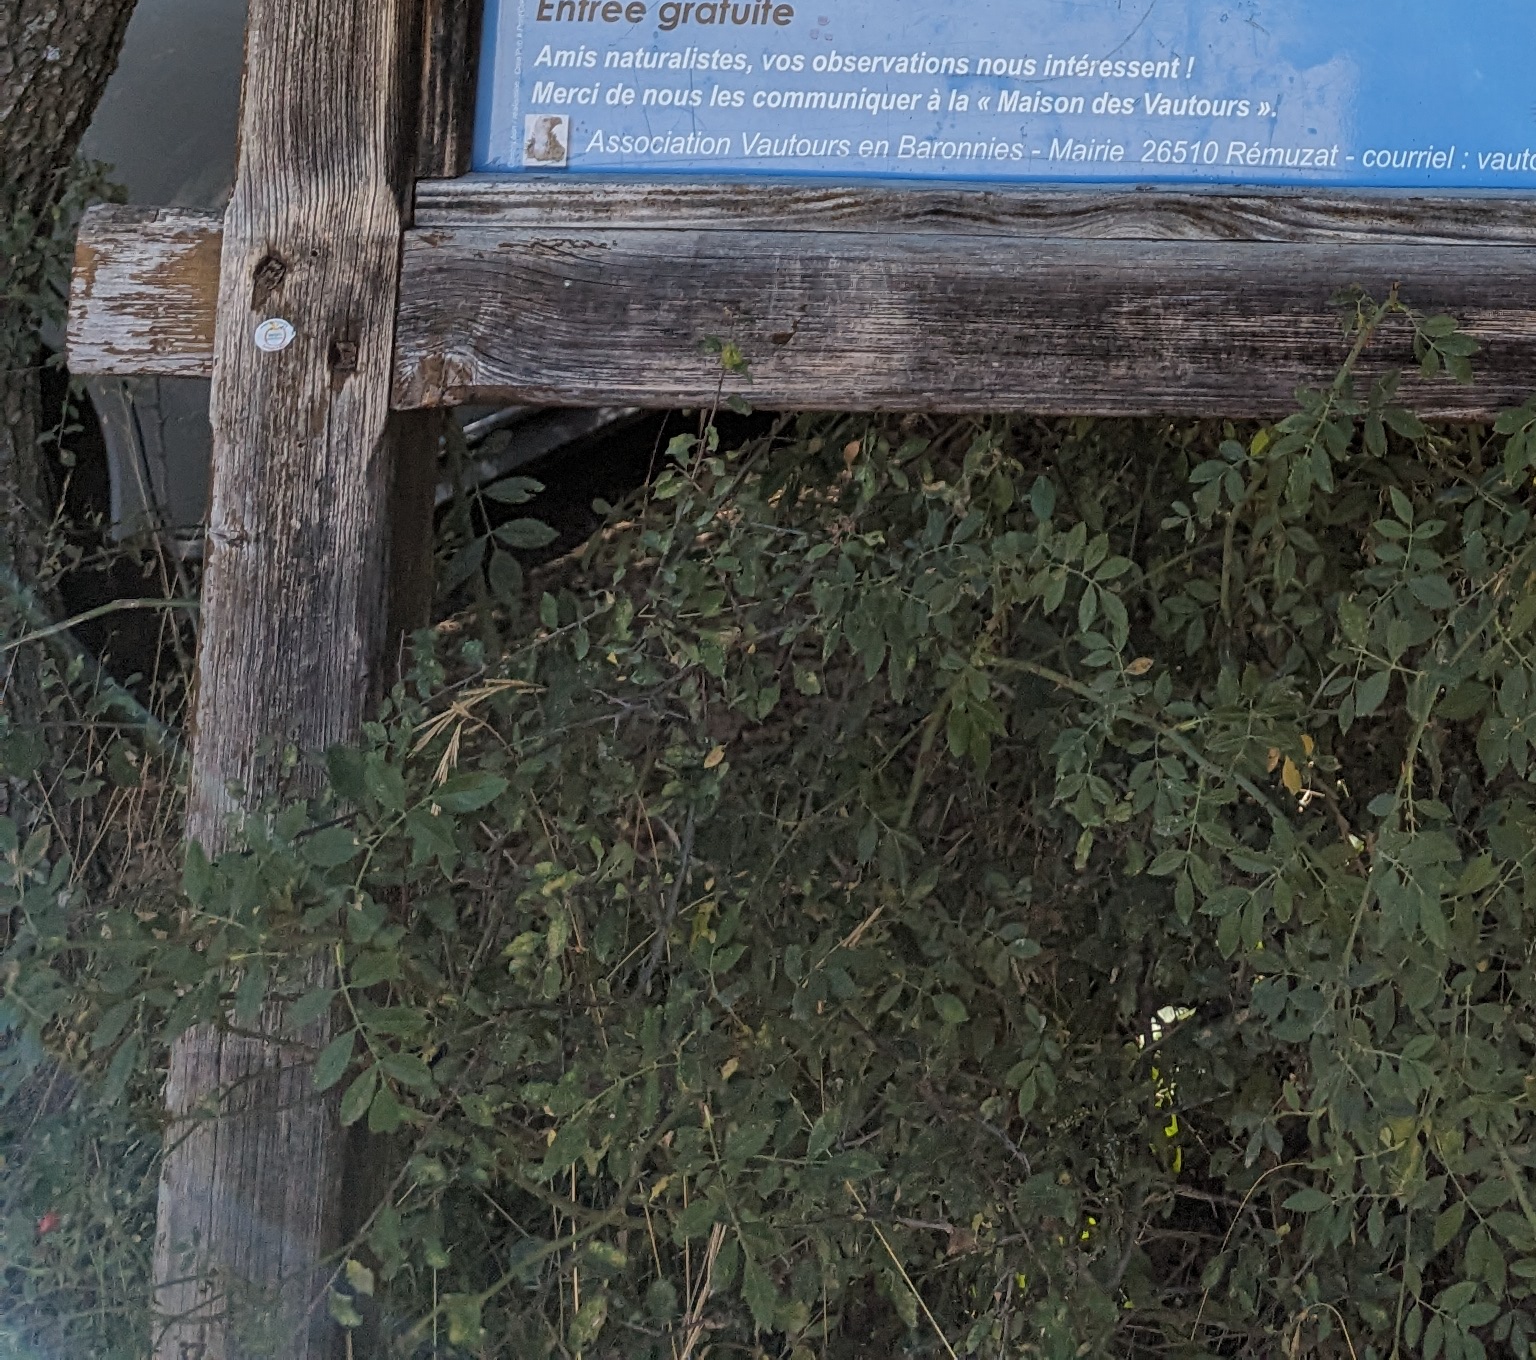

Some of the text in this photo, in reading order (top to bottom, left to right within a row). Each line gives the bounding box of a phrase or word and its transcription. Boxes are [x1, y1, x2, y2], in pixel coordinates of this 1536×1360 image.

[533, 44, 598, 68] Amis
[603, 46, 753, 75] naturalistes,
[762, 54, 806, 72] vos
[812, 49, 970, 75] observations
[976, 57, 1037, 76] nous
[1043, 53, 1181, 79] intéressent
[531, 81, 601, 105] Merci
[605, 82, 636, 105] de
[642, 88, 703, 107] nous
[709, 84, 746, 108] les
[752, 87, 923, 116] communiquer
[927, 87, 941, 111] à
[947, 88, 969, 112] la
[996, 89, 1085, 114] Maison
[1091, 91, 1136, 115] des
[1144, 92, 1251, 117] Vautours
[585, 129, 731, 155] Association
[742, 131, 851, 157] Vautours
[858, 139, 889, 159] en
[897, 134, 1024, 161] Baronnies
[1048, 137, 1125, 162] Mairie
[1140, 139, 1219, 164] 26510
[1225, 141, 1340, 167] Rémuzat
[1362, 144, 1456, 170] courriel
